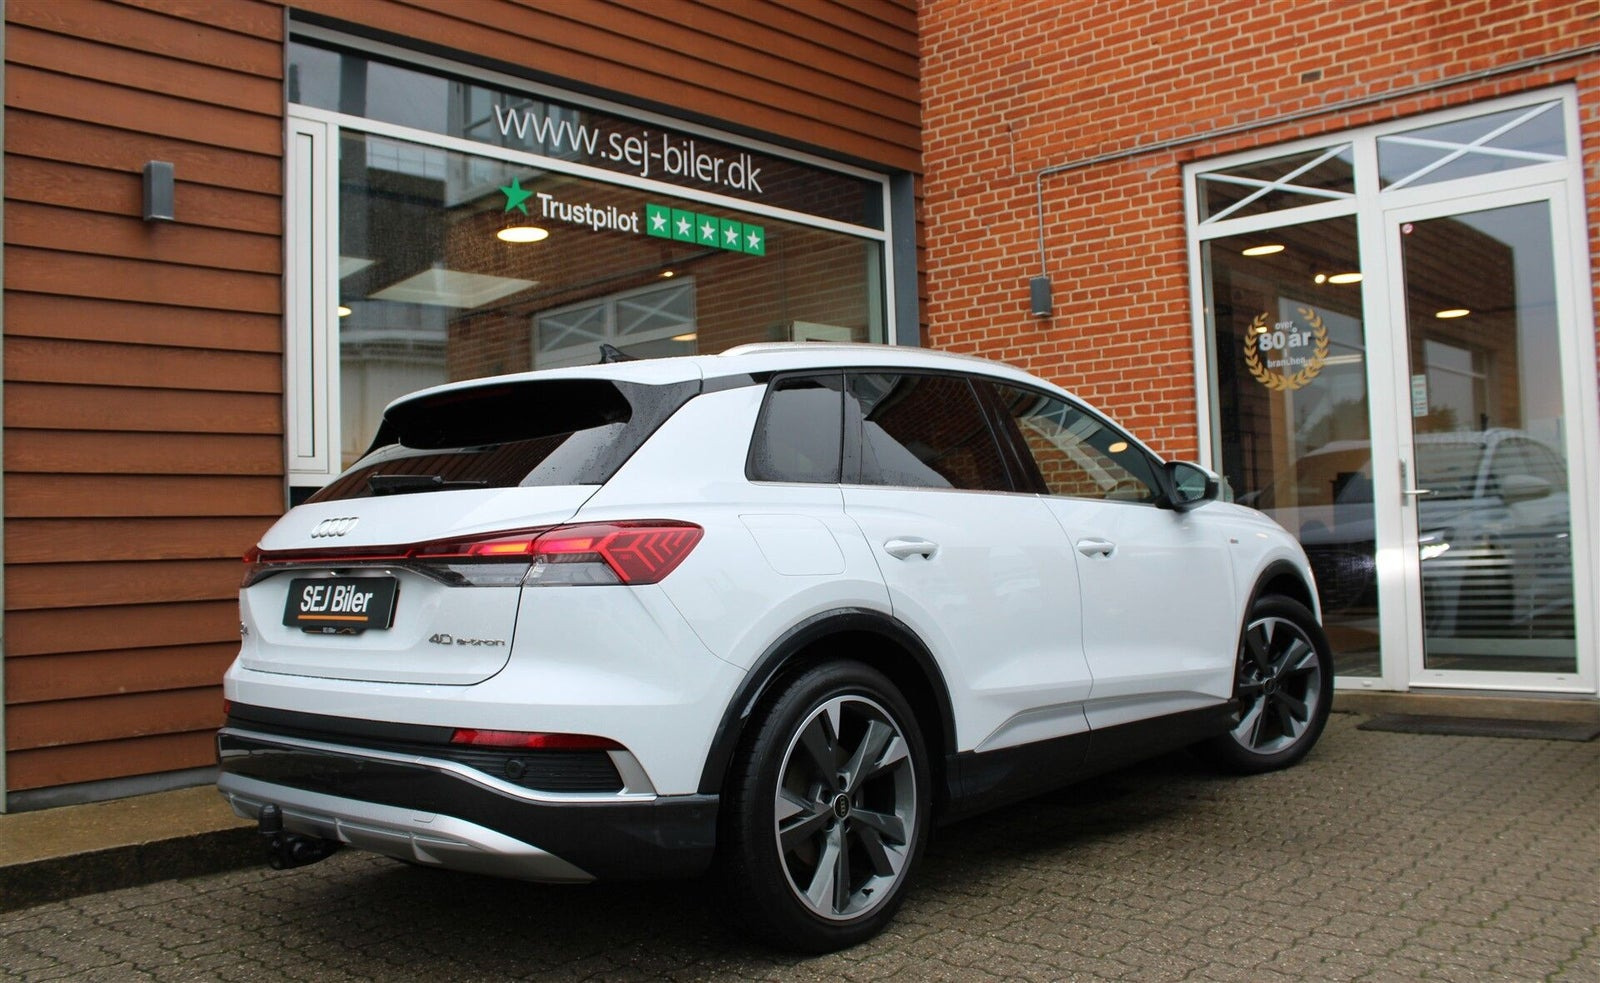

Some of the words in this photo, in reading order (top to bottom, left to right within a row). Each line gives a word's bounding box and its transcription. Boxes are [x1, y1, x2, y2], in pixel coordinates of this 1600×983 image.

[495, 105, 763, 193] www.sej-biler.dk
[536, 192, 639, 233] Trustpilot
[1275, 320, 1294, 330] over
[1259, 331, 1286, 351] 80
[1288, 327, 1312, 347] år
[300, 585, 332, 612] SEJ
[330, 585, 374, 613] Biler
[428, 633, 453, 645] 40
